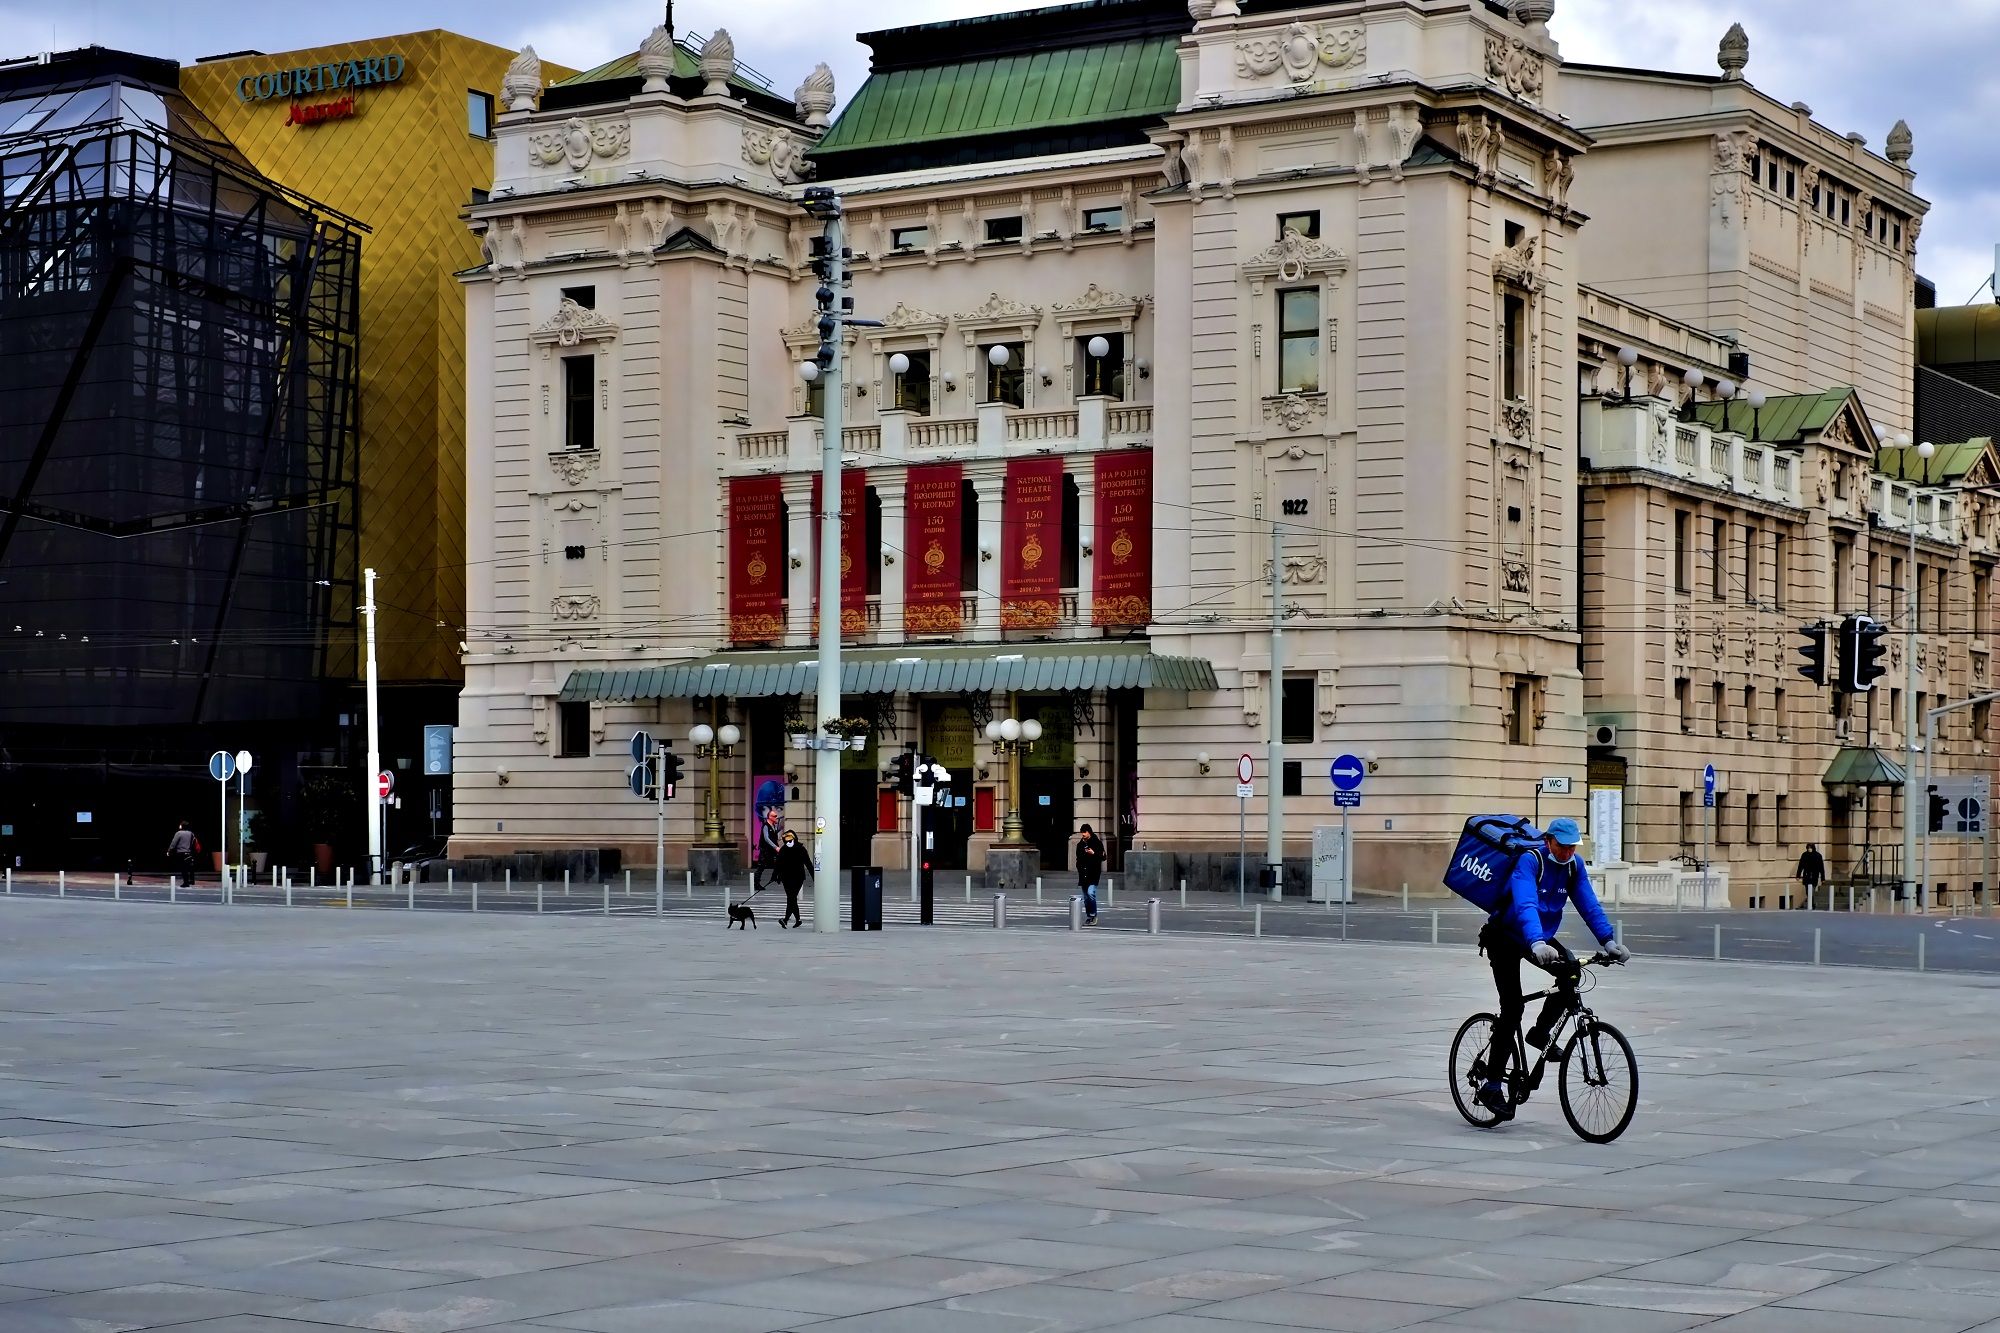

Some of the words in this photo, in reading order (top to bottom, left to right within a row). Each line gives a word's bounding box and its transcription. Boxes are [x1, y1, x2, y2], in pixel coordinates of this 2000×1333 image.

[235, 54, 405, 102] COURTYARD
[1101, 469, 1146, 479] НАРОДНО
[1017, 475, 1052, 484] NATIONAL
[1101, 479, 1146, 489] ПОЗОРИШТЕ
[914, 481, 956, 491] НАРОДНО
[1017, 485, 1052, 493] THEATRE
[735, 494, 776, 503] НАРОДНО
[914, 491, 956, 500] ПОЗОРИШТЕ
[922, 500, 956, 509] БЕОГРАДУ
[1114, 504, 1132, 514] 150
[1282, 499, 1308, 515] 1922
[927, 515, 944, 525] 150
[1026, 510, 1043, 520] 150
[749, 527, 765, 537] 150
[946, 746, 963, 755] 150
[1460, 854, 1494, 882] Wolt
